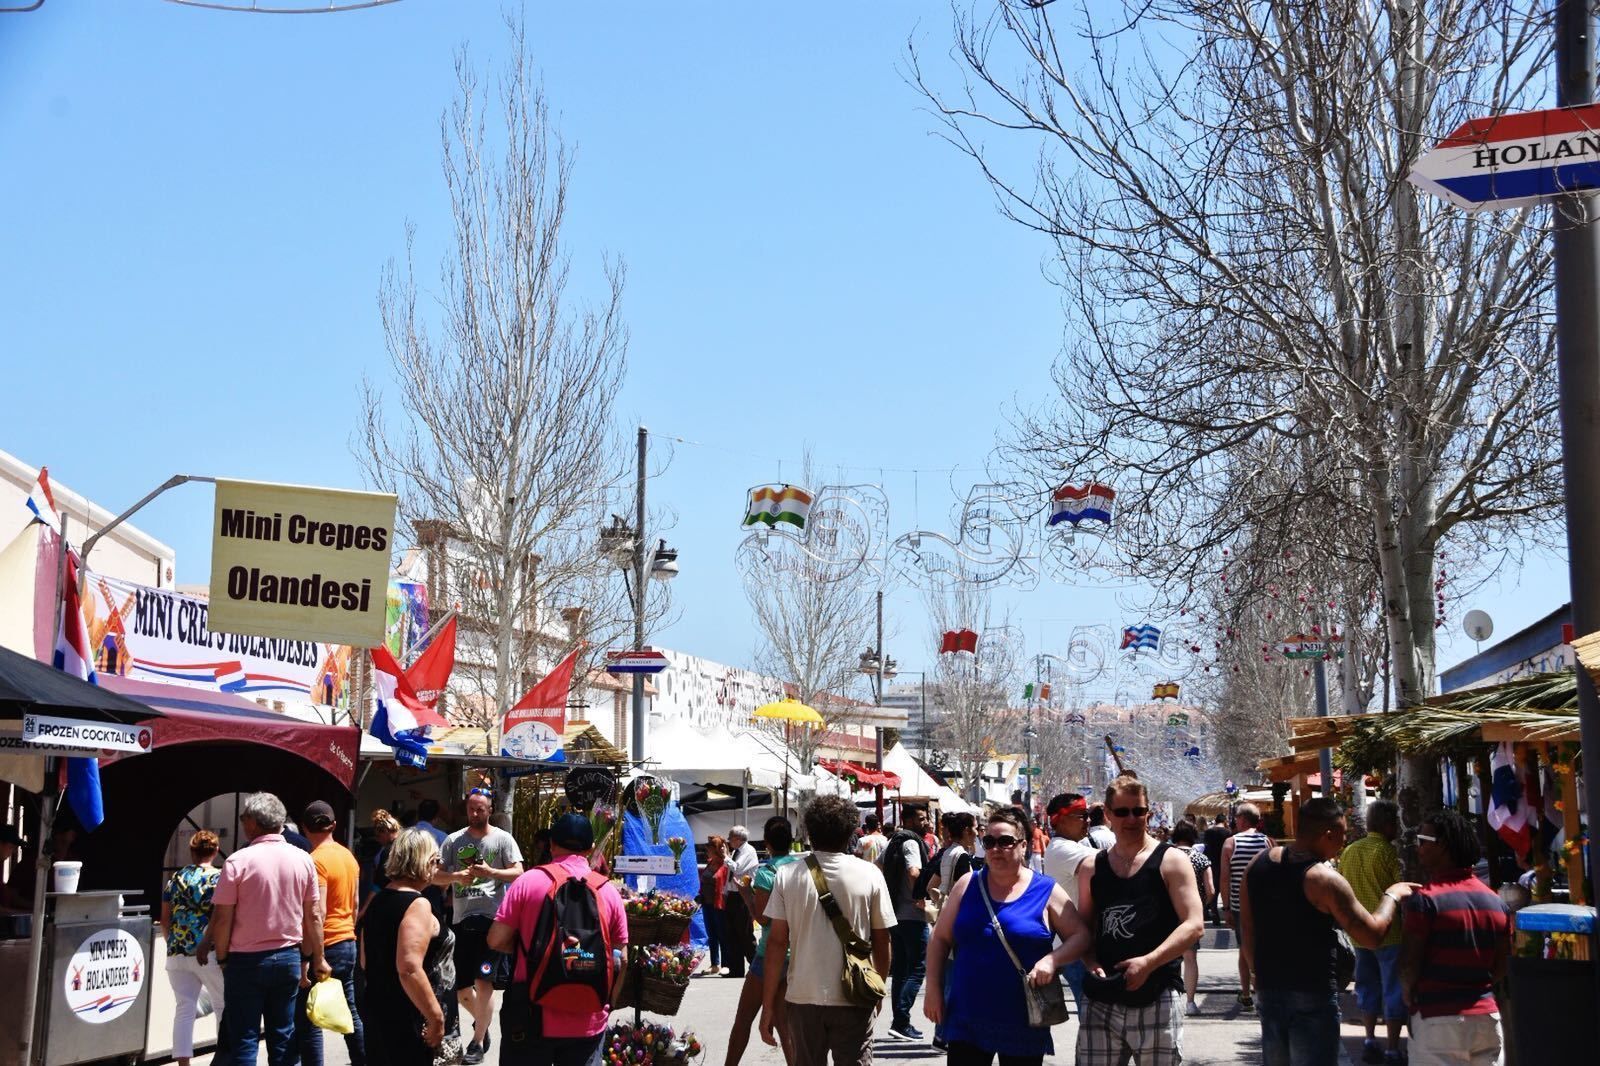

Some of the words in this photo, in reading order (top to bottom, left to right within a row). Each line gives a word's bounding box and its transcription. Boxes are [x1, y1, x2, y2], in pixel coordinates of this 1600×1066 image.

[1472, 135, 1600, 169] HOLAN
[220, 508, 282, 542] Mini
[288, 514, 388, 552] Crepes
[227, 565, 372, 613] Olandesi
[134, 588, 174, 641] MINI
[38, 723, 80, 739] FROZEN
[81, 728, 136, 744] COCKTAILS
[89, 940, 106, 962] MINI
[106, 938, 128, 960] CREPS
[86, 966, 130, 992] HOLANDESES
